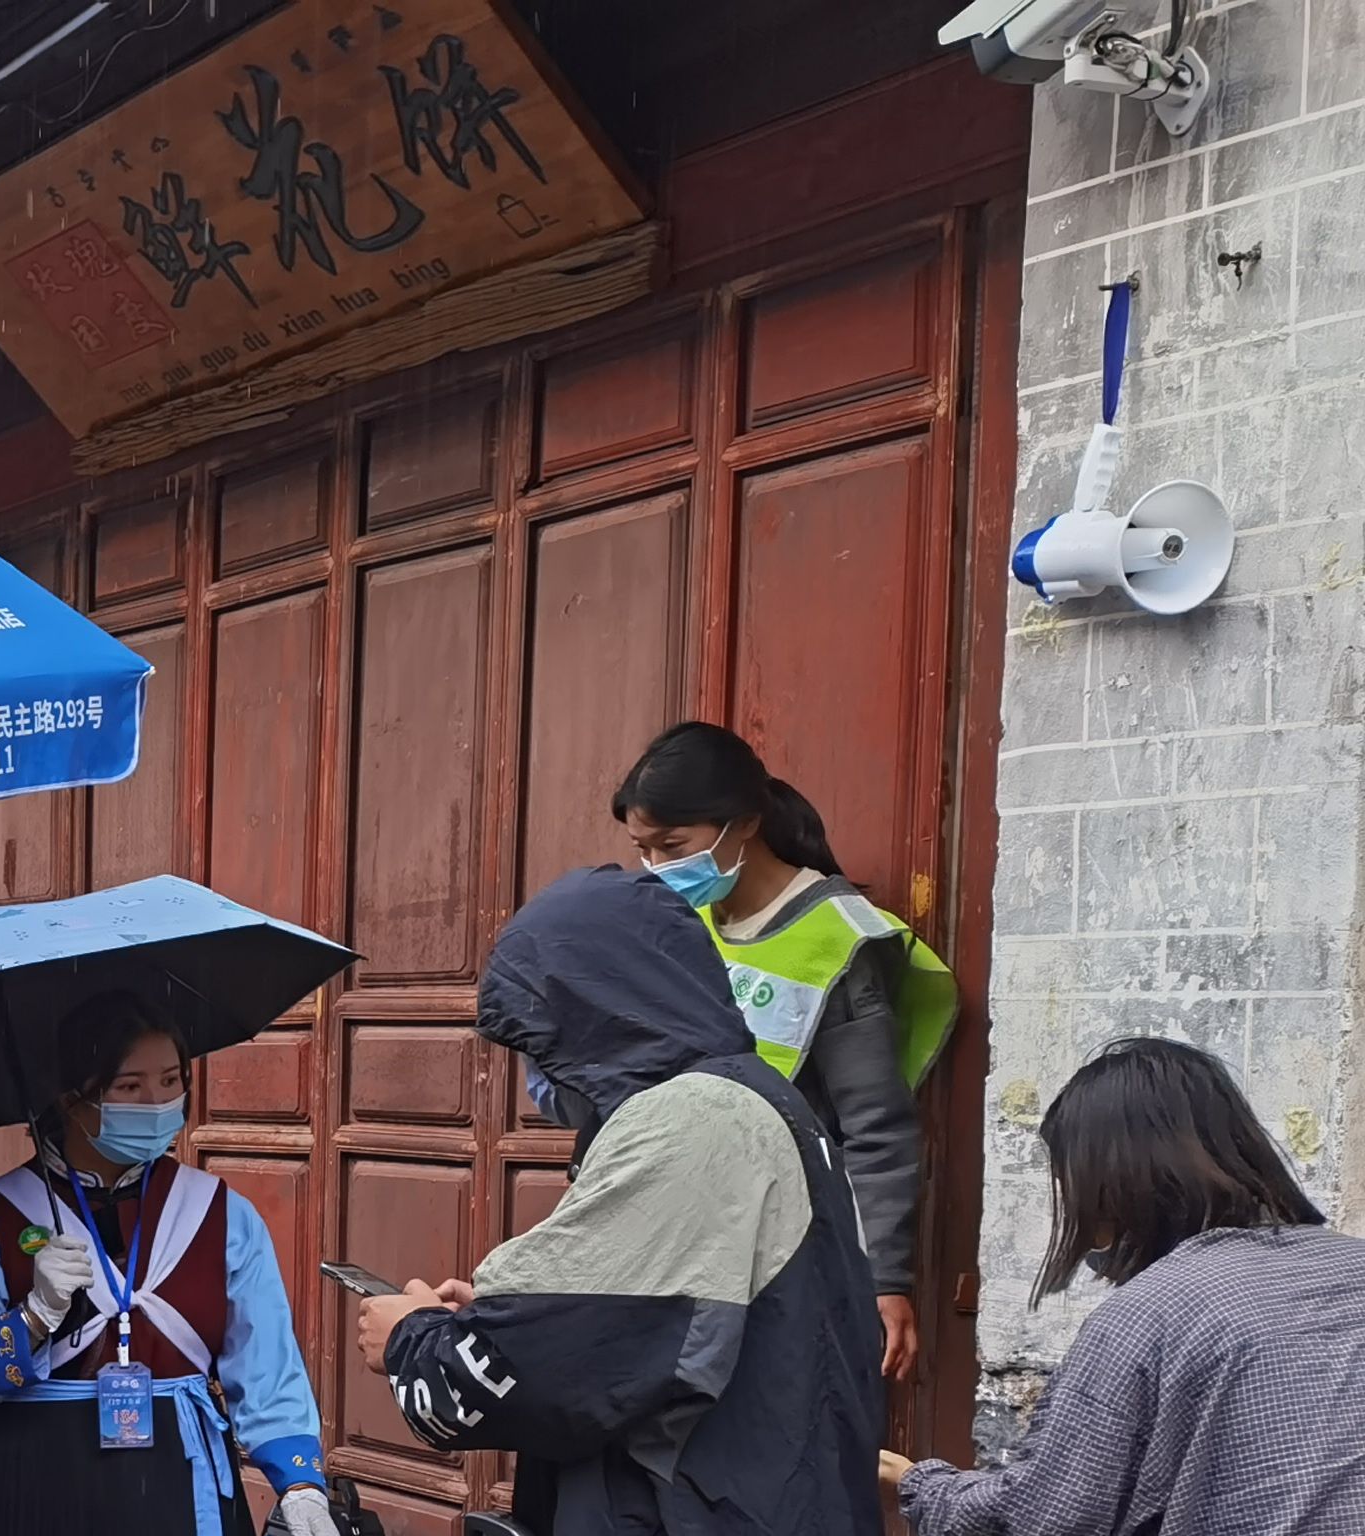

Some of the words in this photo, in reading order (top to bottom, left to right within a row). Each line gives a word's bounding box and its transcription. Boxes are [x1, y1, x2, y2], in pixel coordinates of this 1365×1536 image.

[200, 348, 237, 373] guo
[242, 329, 271, 352] du
[278, 309, 327, 338] xian
[330, 287, 379, 315] hua
[389, 255, 451, 290] bing
